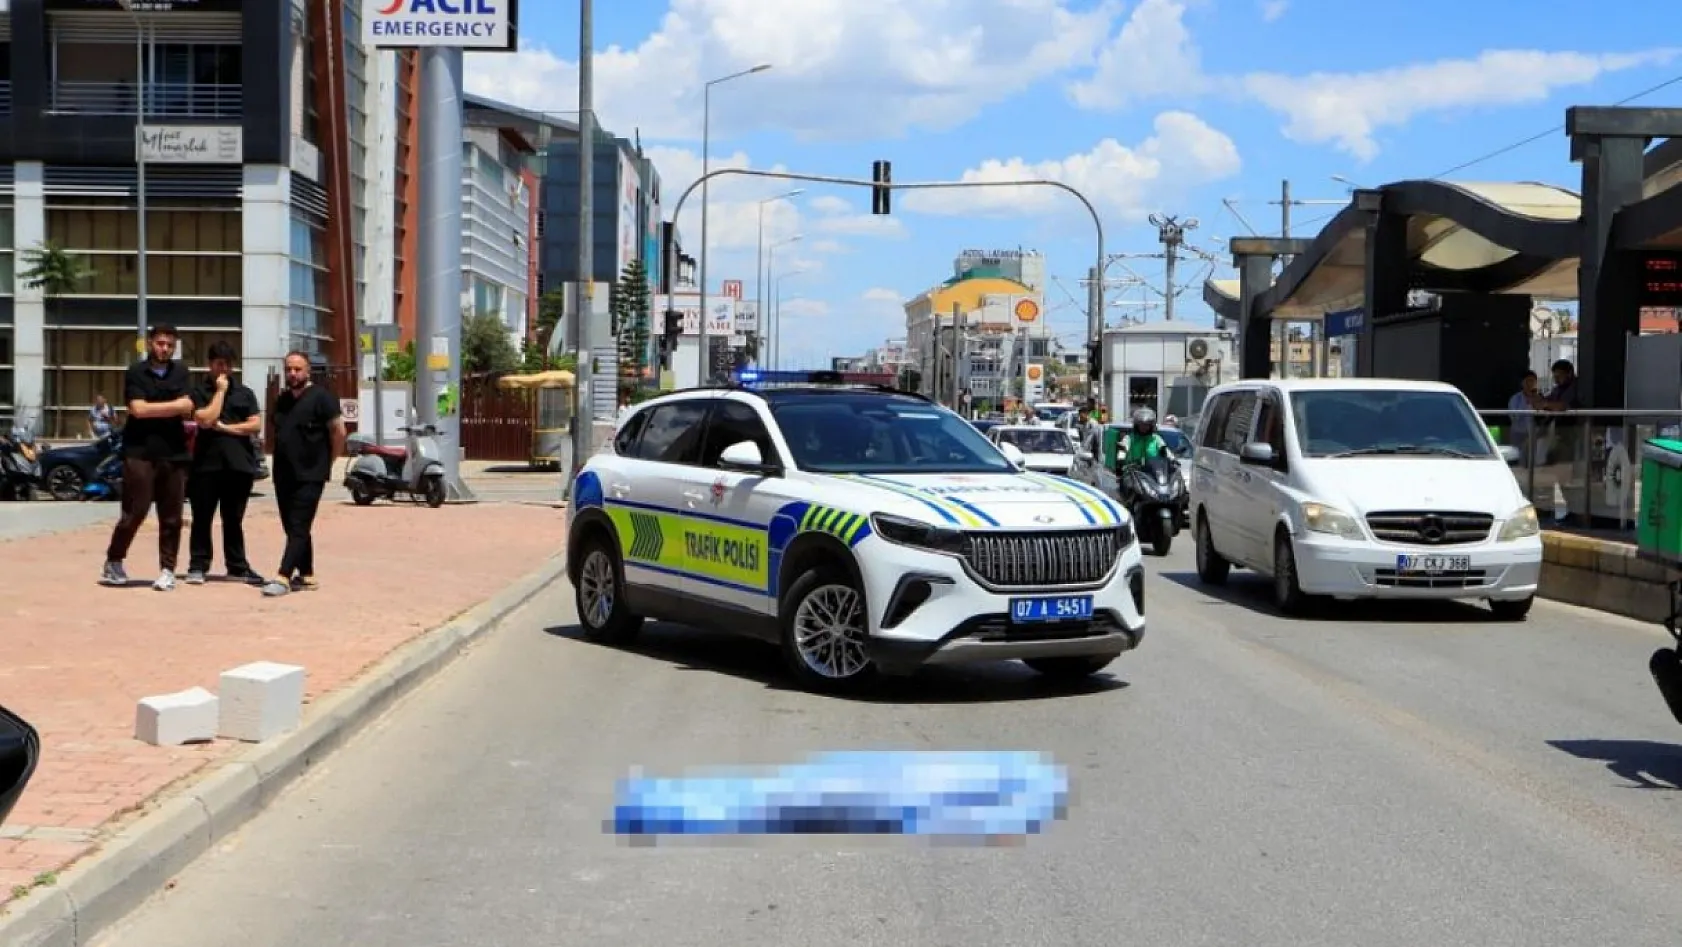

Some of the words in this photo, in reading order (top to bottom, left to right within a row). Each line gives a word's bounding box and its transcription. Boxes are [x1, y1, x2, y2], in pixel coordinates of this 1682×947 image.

[372, 21, 496, 37] EMERGENCY
[684, 530, 721, 563] TRAFİK
[724, 536, 759, 572] POLİSİ
[1405, 557, 1418, 570] 07
[1424, 557, 1445, 570] CKJ
[1017, 601, 1033, 617] 07
[1040, 599, 1048, 615] A
[1057, 598, 1087, 615] 5451
